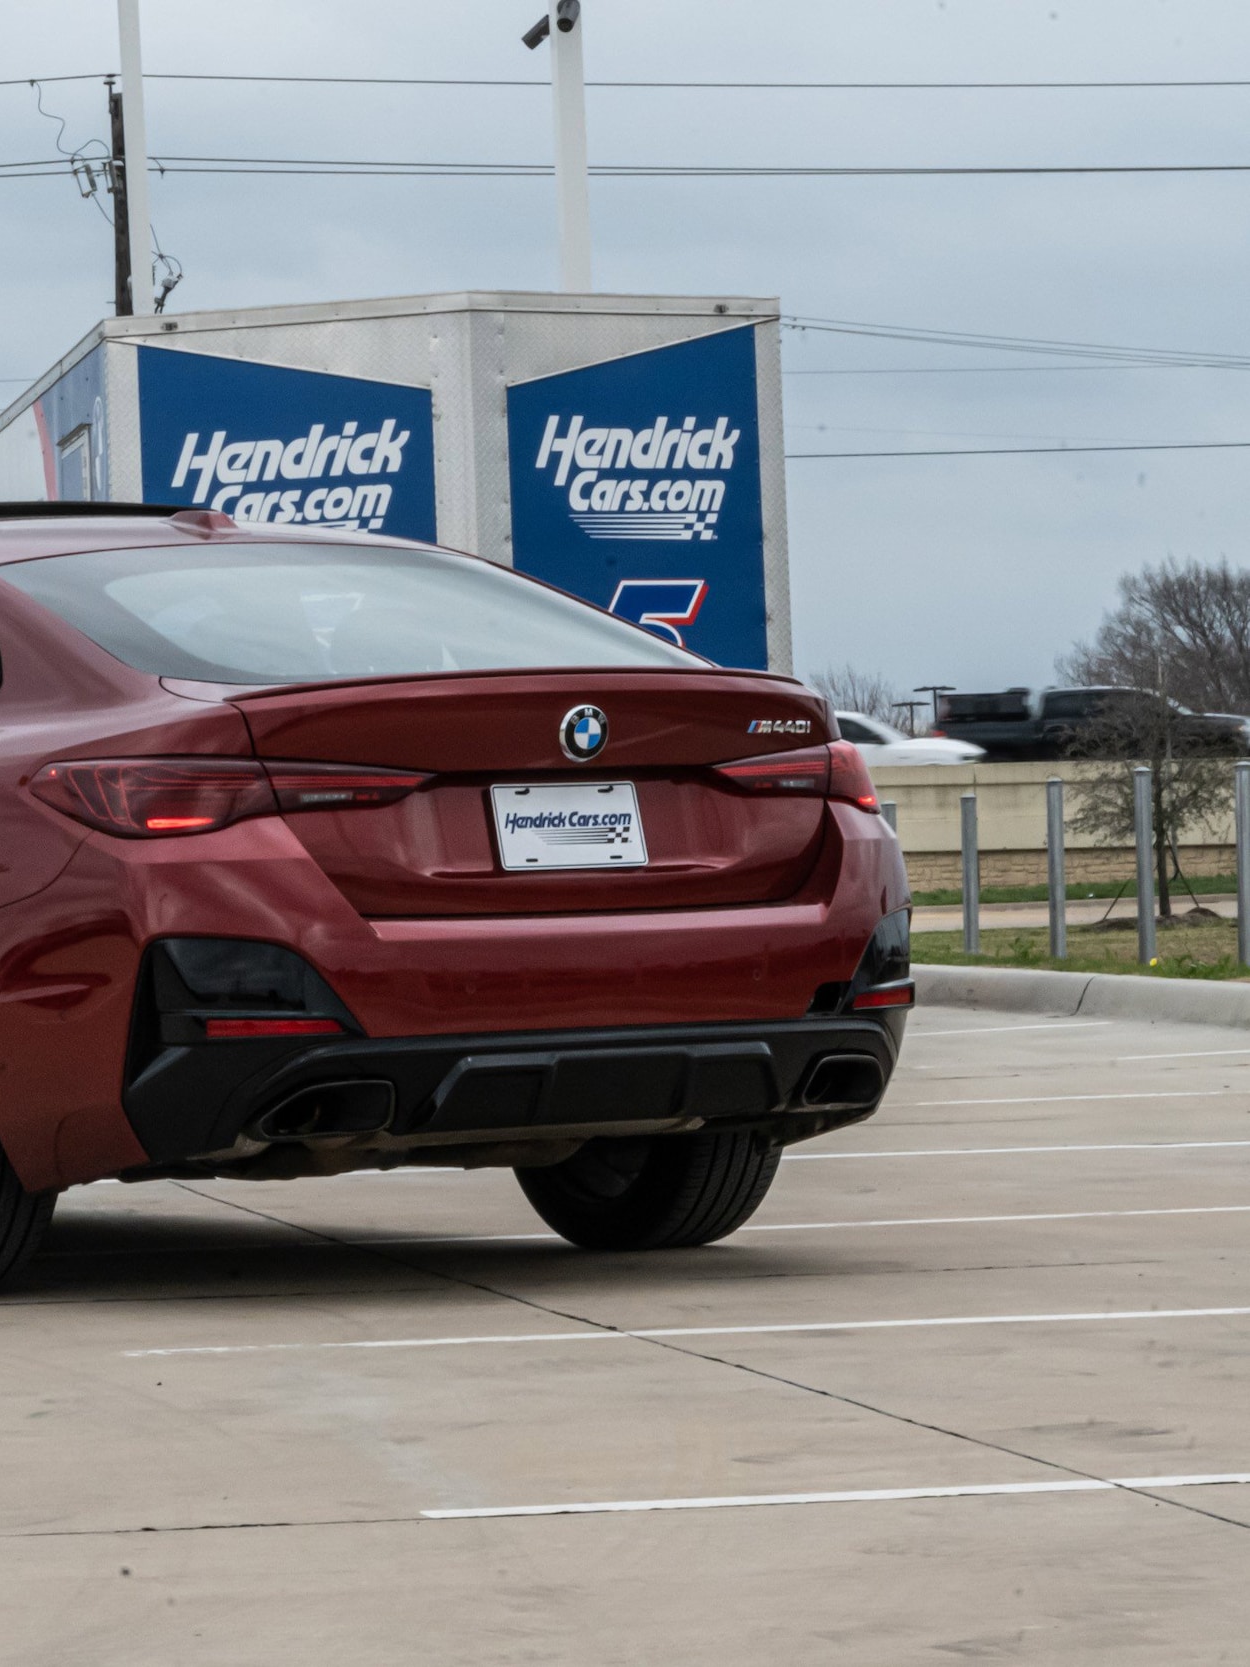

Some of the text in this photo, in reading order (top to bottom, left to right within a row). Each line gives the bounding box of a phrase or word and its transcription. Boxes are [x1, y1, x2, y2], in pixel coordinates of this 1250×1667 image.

[171, 419, 410, 503] Hendrick
[535, 415, 740, 486] Hendrick
[210, 483, 393, 523] Cars.com
[568, 470, 726, 511] Cars.com
